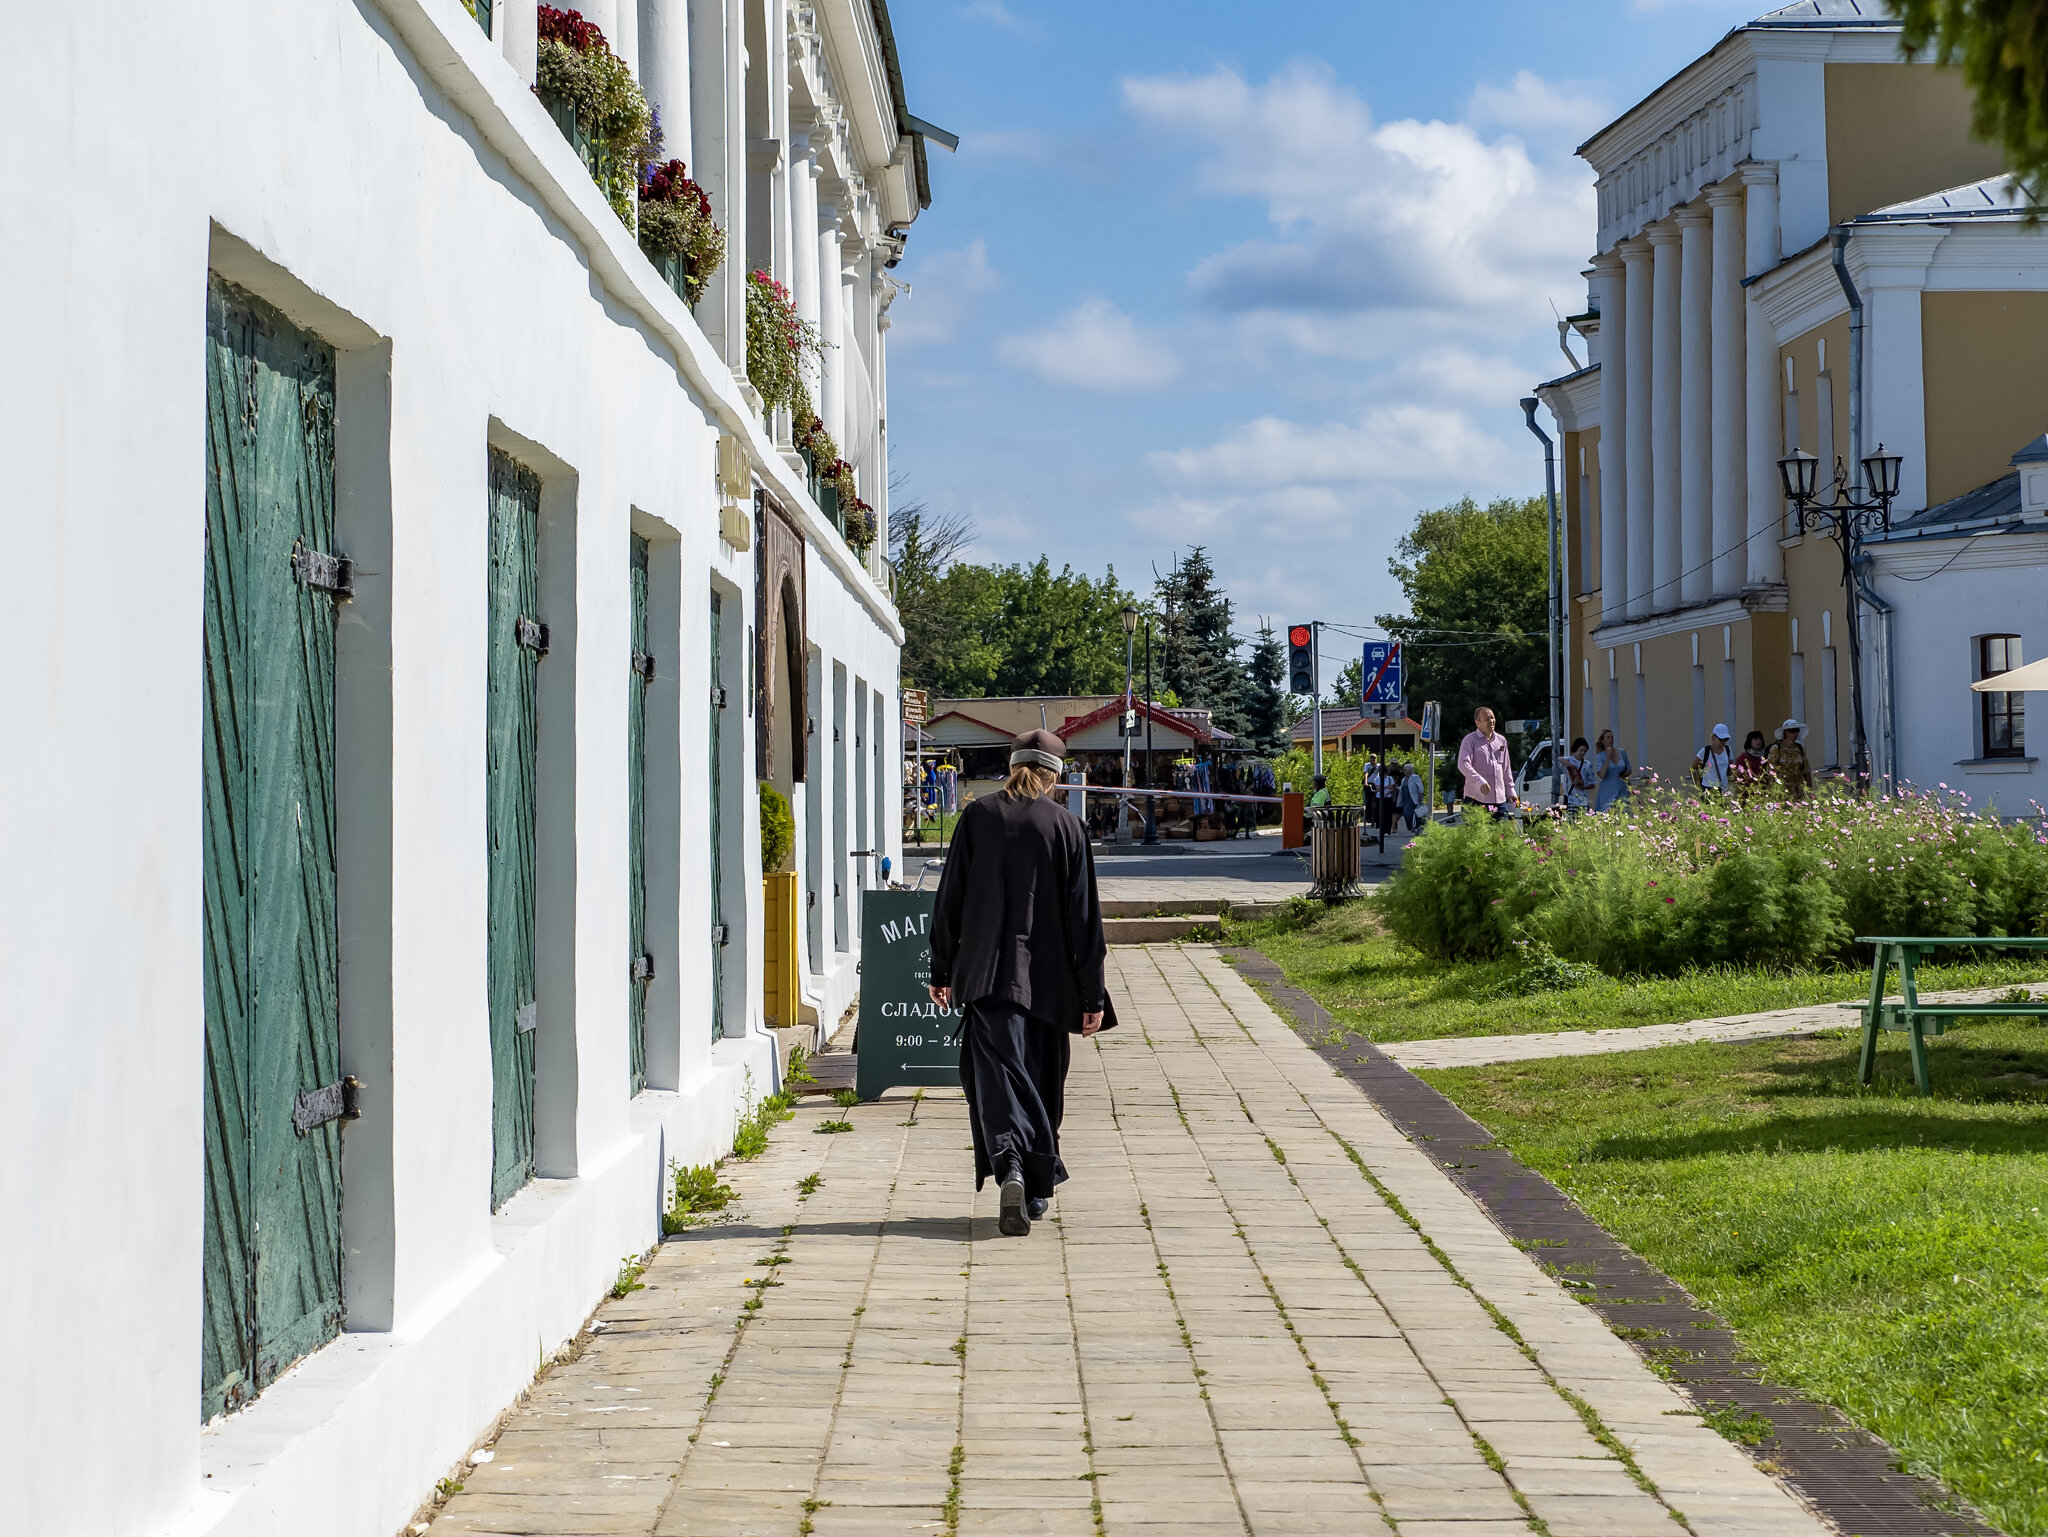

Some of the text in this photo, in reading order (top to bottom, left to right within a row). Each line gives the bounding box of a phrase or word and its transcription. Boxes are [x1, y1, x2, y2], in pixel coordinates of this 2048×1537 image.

[881, 913, 929, 944] МАГ
[881, 1002, 966, 1020] СЛАДОС
[896, 1034, 922, 1047] 9:00
